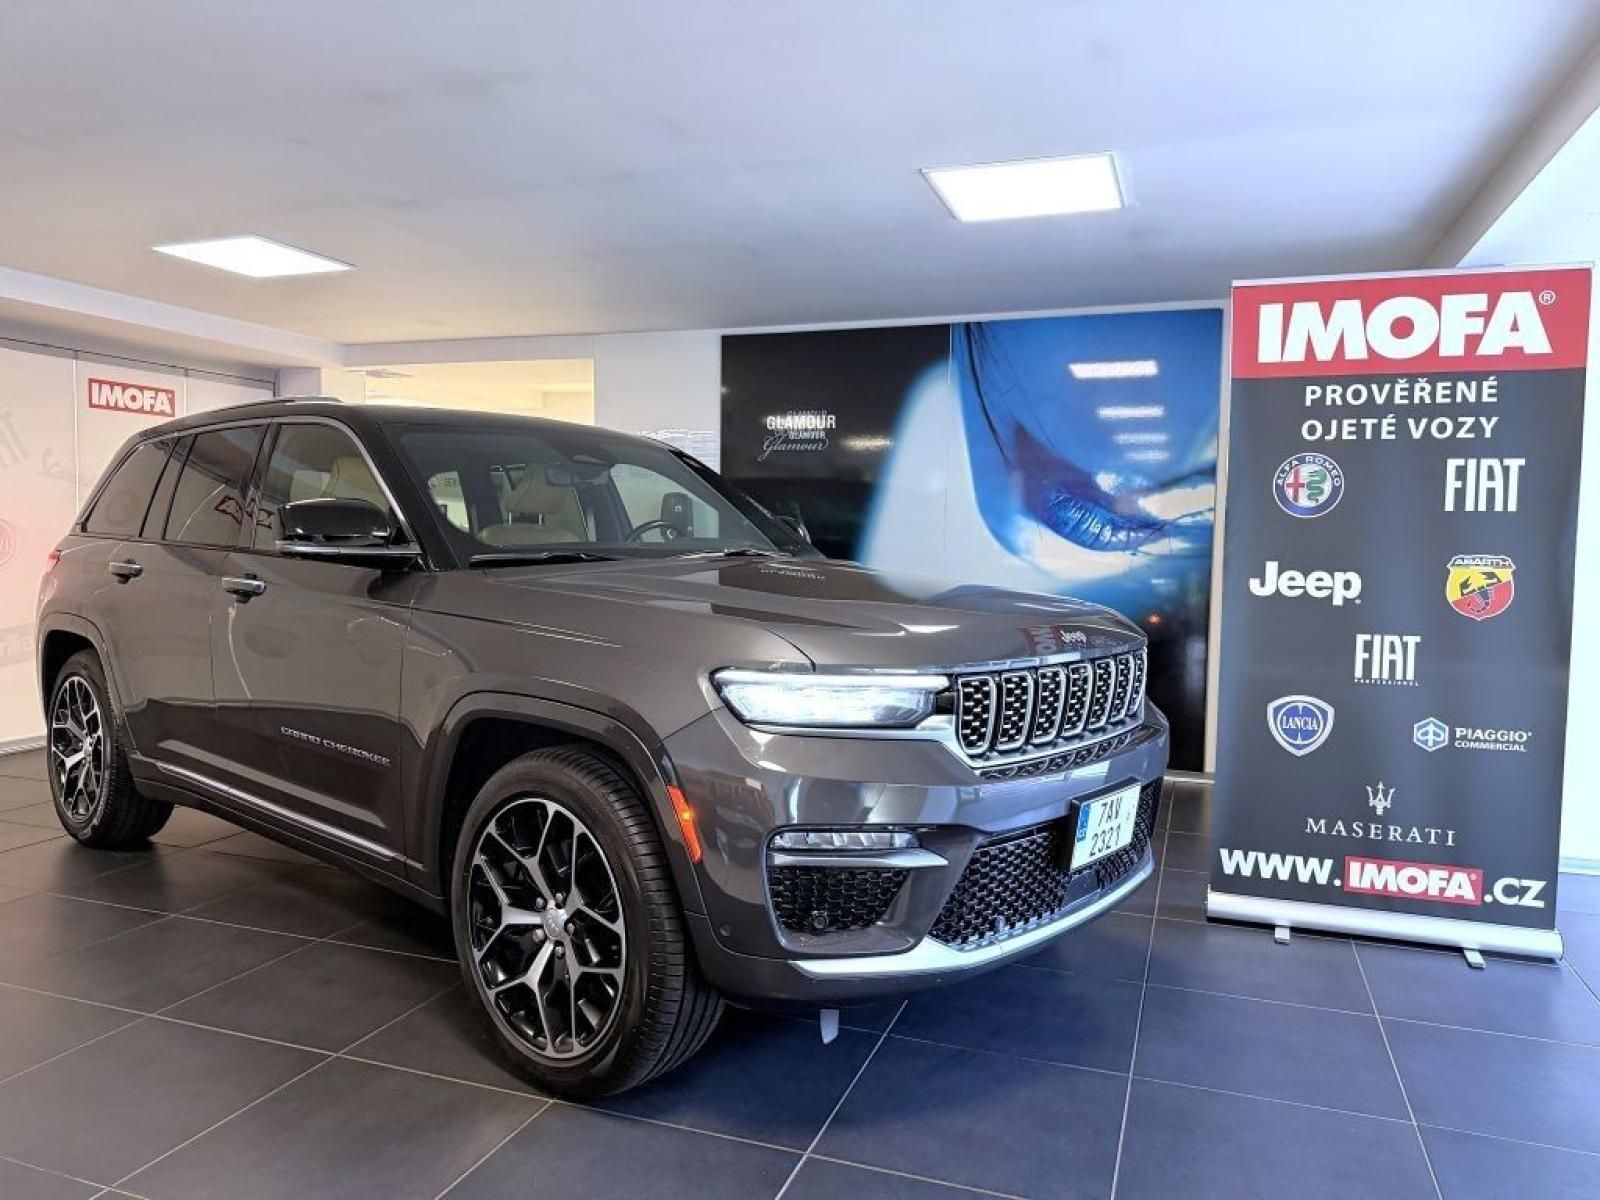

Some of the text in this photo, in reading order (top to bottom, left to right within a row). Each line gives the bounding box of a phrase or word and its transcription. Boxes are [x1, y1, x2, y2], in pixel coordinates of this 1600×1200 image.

[91, 382, 173, 414] IMOFA
[1305, 376, 1498, 407] PROVĚŘENÉ
[766, 415, 837, 430] GLAMOUR
[1301, 414, 1499, 441] OJETÉ VOZY
[1444, 458, 1526, 512] FIAT
[1249, 561, 1362, 606] Jeep
[1354, 633, 1421, 681] FIAT
[1282, 715, 1320, 731] LANCIA
[1454, 727, 1528, 743] PIAGGIO
[1454, 740, 1528, 752] COMMERCIAL
[1089, 823, 1122, 857] 2321
[1304, 818, 1456, 846] MASERATI
